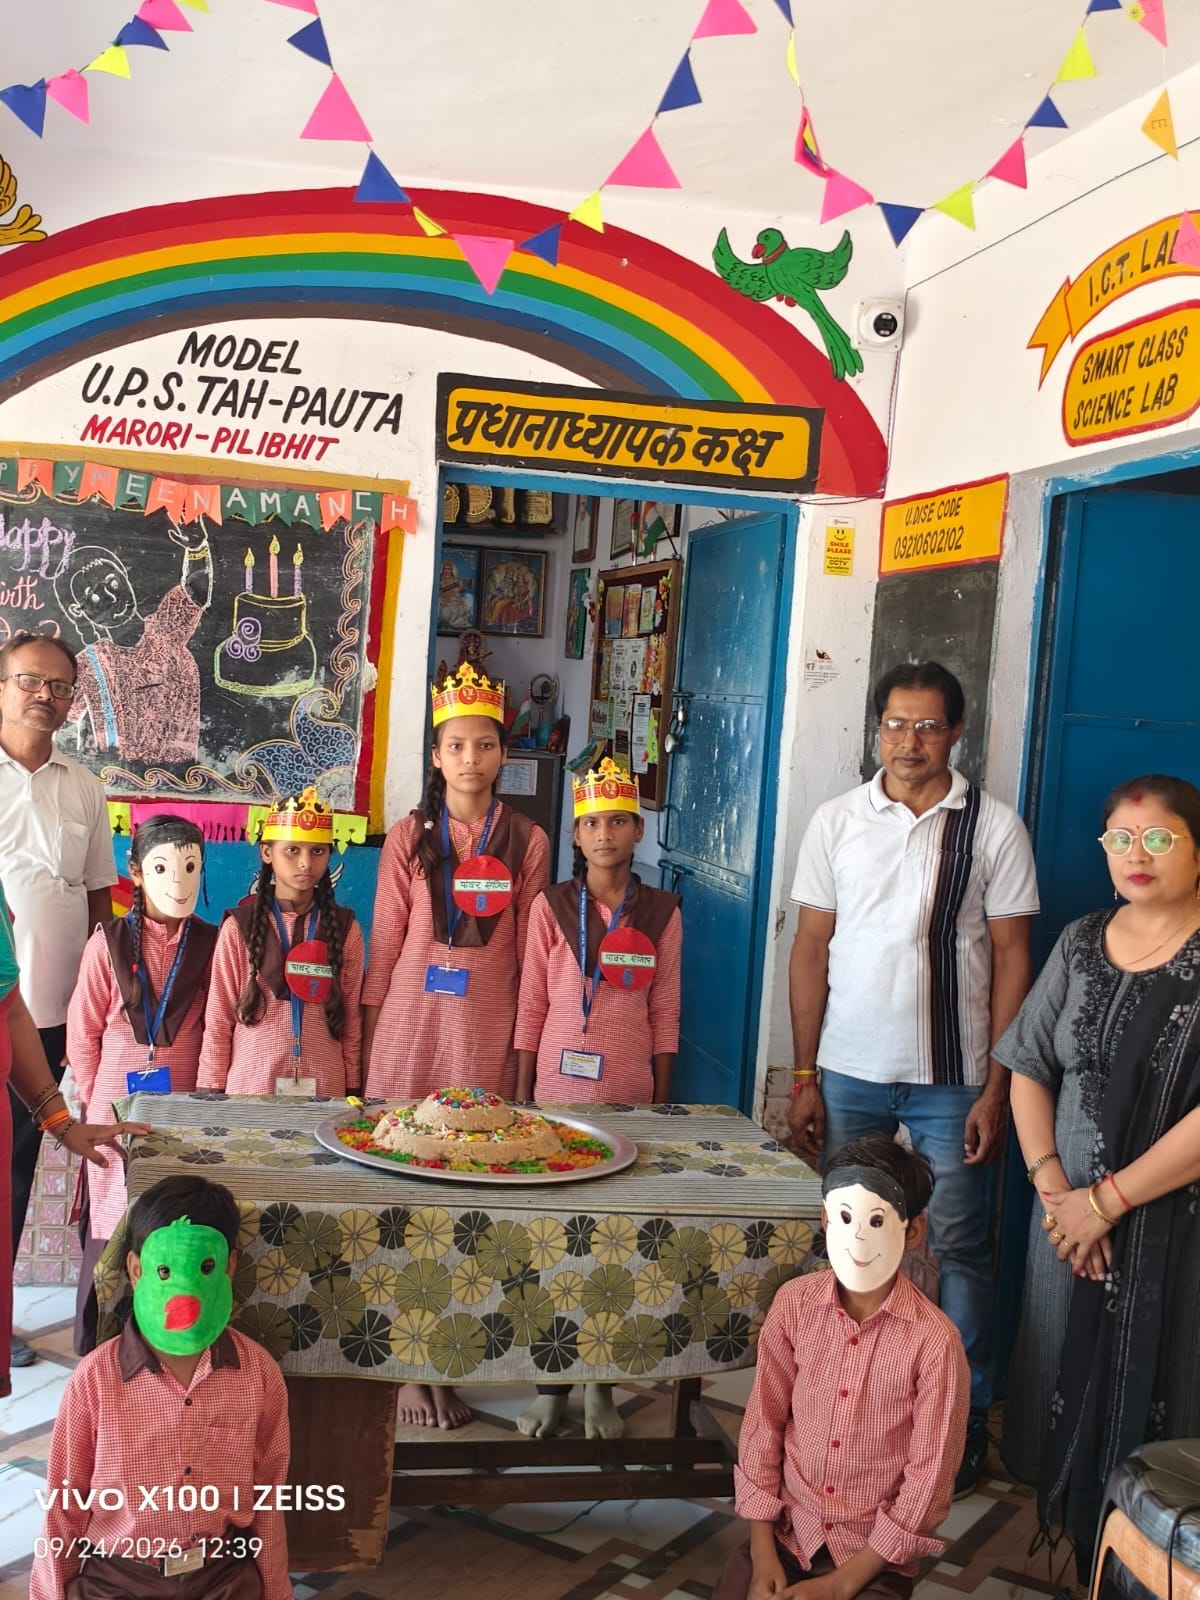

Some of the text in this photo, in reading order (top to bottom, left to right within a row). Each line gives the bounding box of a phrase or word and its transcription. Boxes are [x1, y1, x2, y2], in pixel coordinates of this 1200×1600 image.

[1089, 251, 1134, 308] I.C.T.
[177, 331, 302, 375] MODEL
[1082, 325, 1188, 385] SMART CLASS
[197, 375, 404, 435] TAH-PAUTA
[1073, 372, 1178, 430] SCIENCE LAB
[448, 400, 784, 476] प्रधानाध्यापक कक्ष
[904, 496, 963, 527] U.DISE CODE
[826, 547, 852, 555] PLEASE
[893, 525, 965, 560] 09210602102
[0, 575, 45, 611] irth
[308, 979, 320, 999] 7
